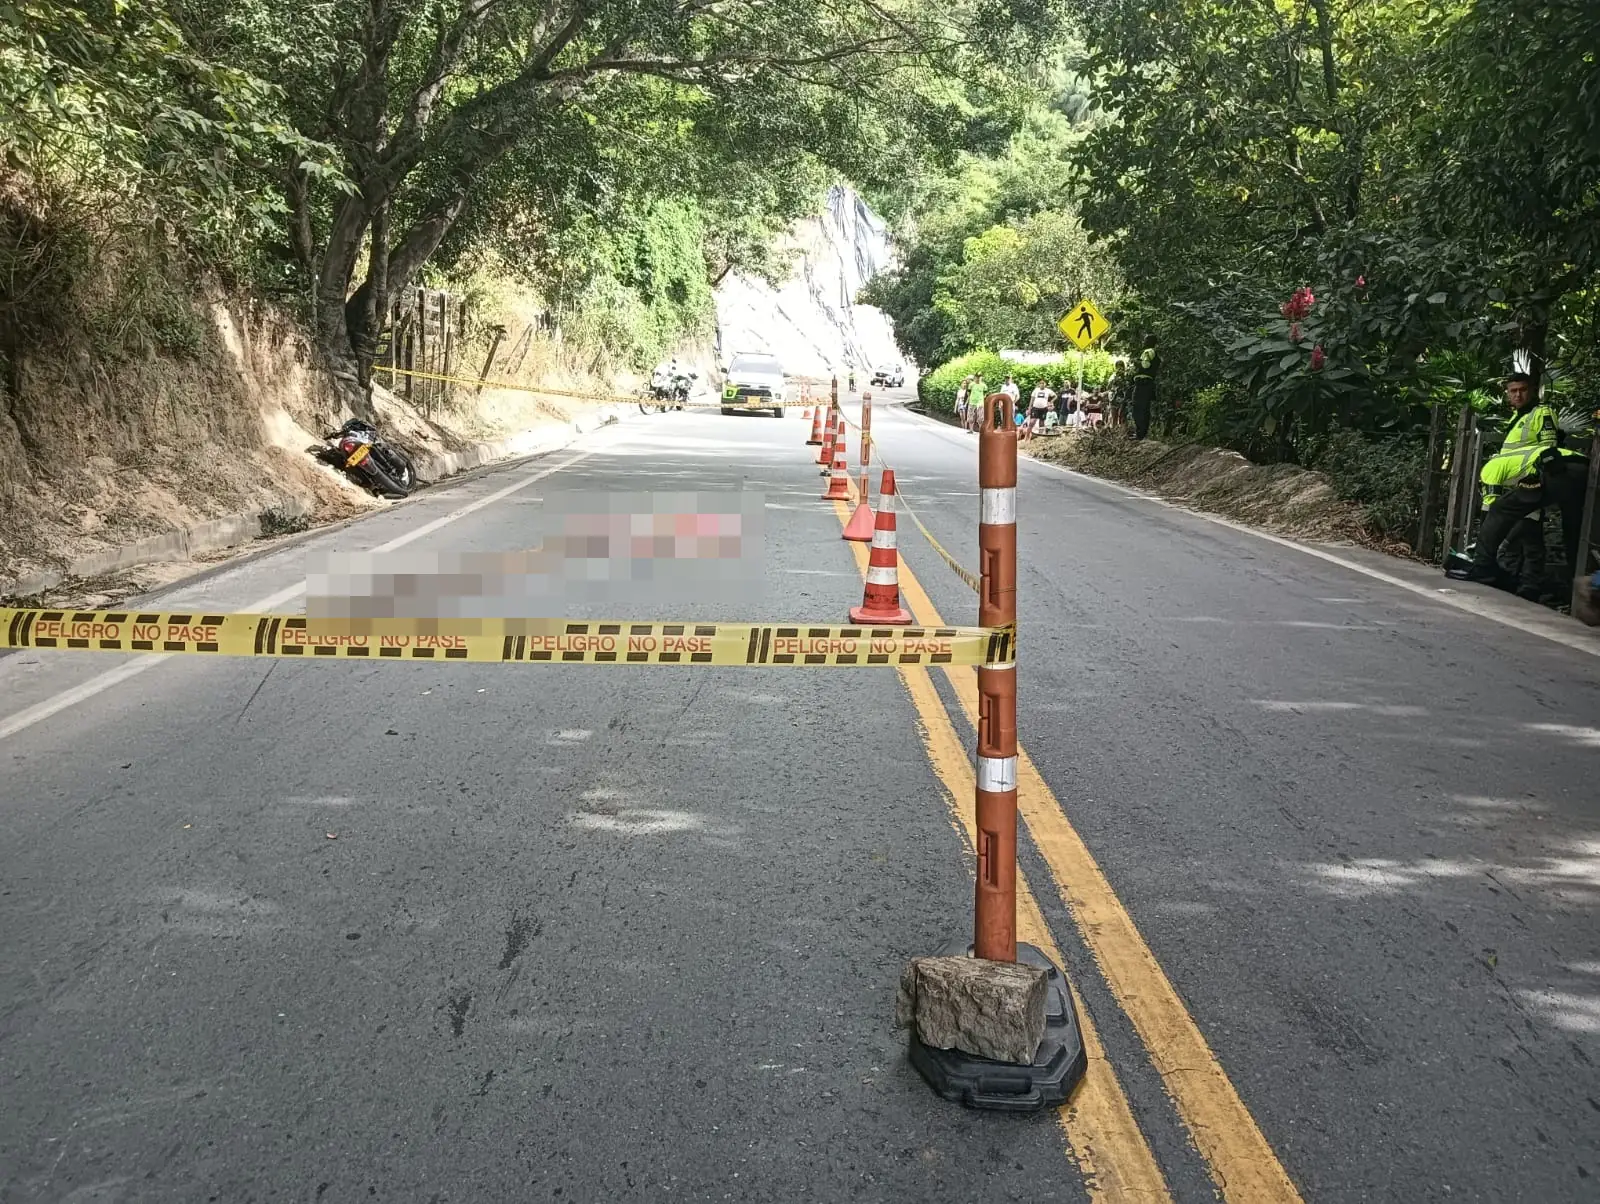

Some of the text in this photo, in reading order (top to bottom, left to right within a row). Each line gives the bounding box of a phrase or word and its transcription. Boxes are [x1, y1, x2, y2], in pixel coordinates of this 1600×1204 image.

[35, 622, 217, 642] PELIGRO NO PASE
[281, 629, 466, 648] PELIGRO NO PASE
[531, 636, 712, 652] PELIGRO NO PASE
[773, 639, 952, 654] PELIGRO NO PASE
